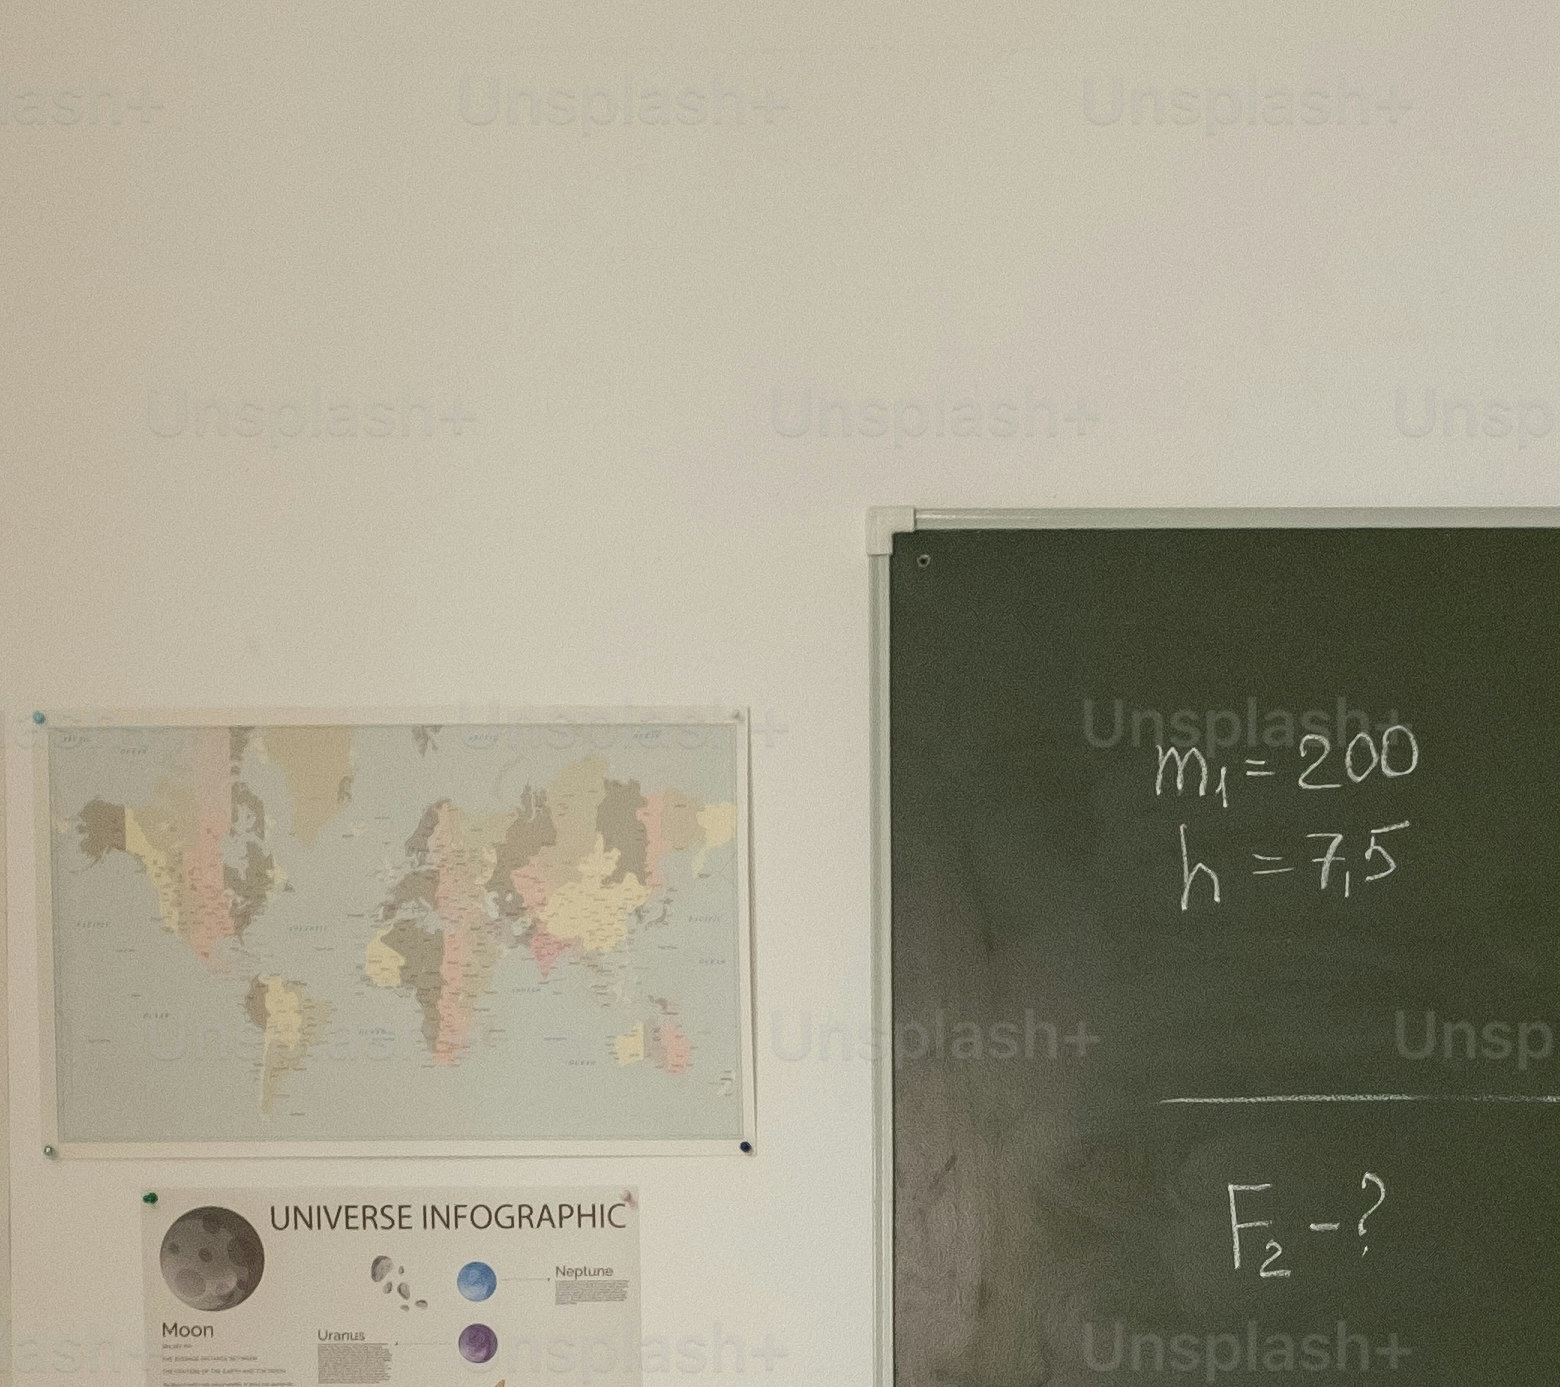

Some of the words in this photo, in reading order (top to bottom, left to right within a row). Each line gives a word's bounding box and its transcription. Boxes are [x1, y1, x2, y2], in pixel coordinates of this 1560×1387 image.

[1298, 723, 1419, 790] 200
[1178, 823, 1221, 911] h
[269, 1203, 414, 1233] UNIVERSE
[421, 1202, 629, 1231] INFOGRAPHIC
[555, 1264, 614, 1281] Neptune
[161, 1321, 215, 1339] Moon
[317, 1329, 366, 1342] Uranus
